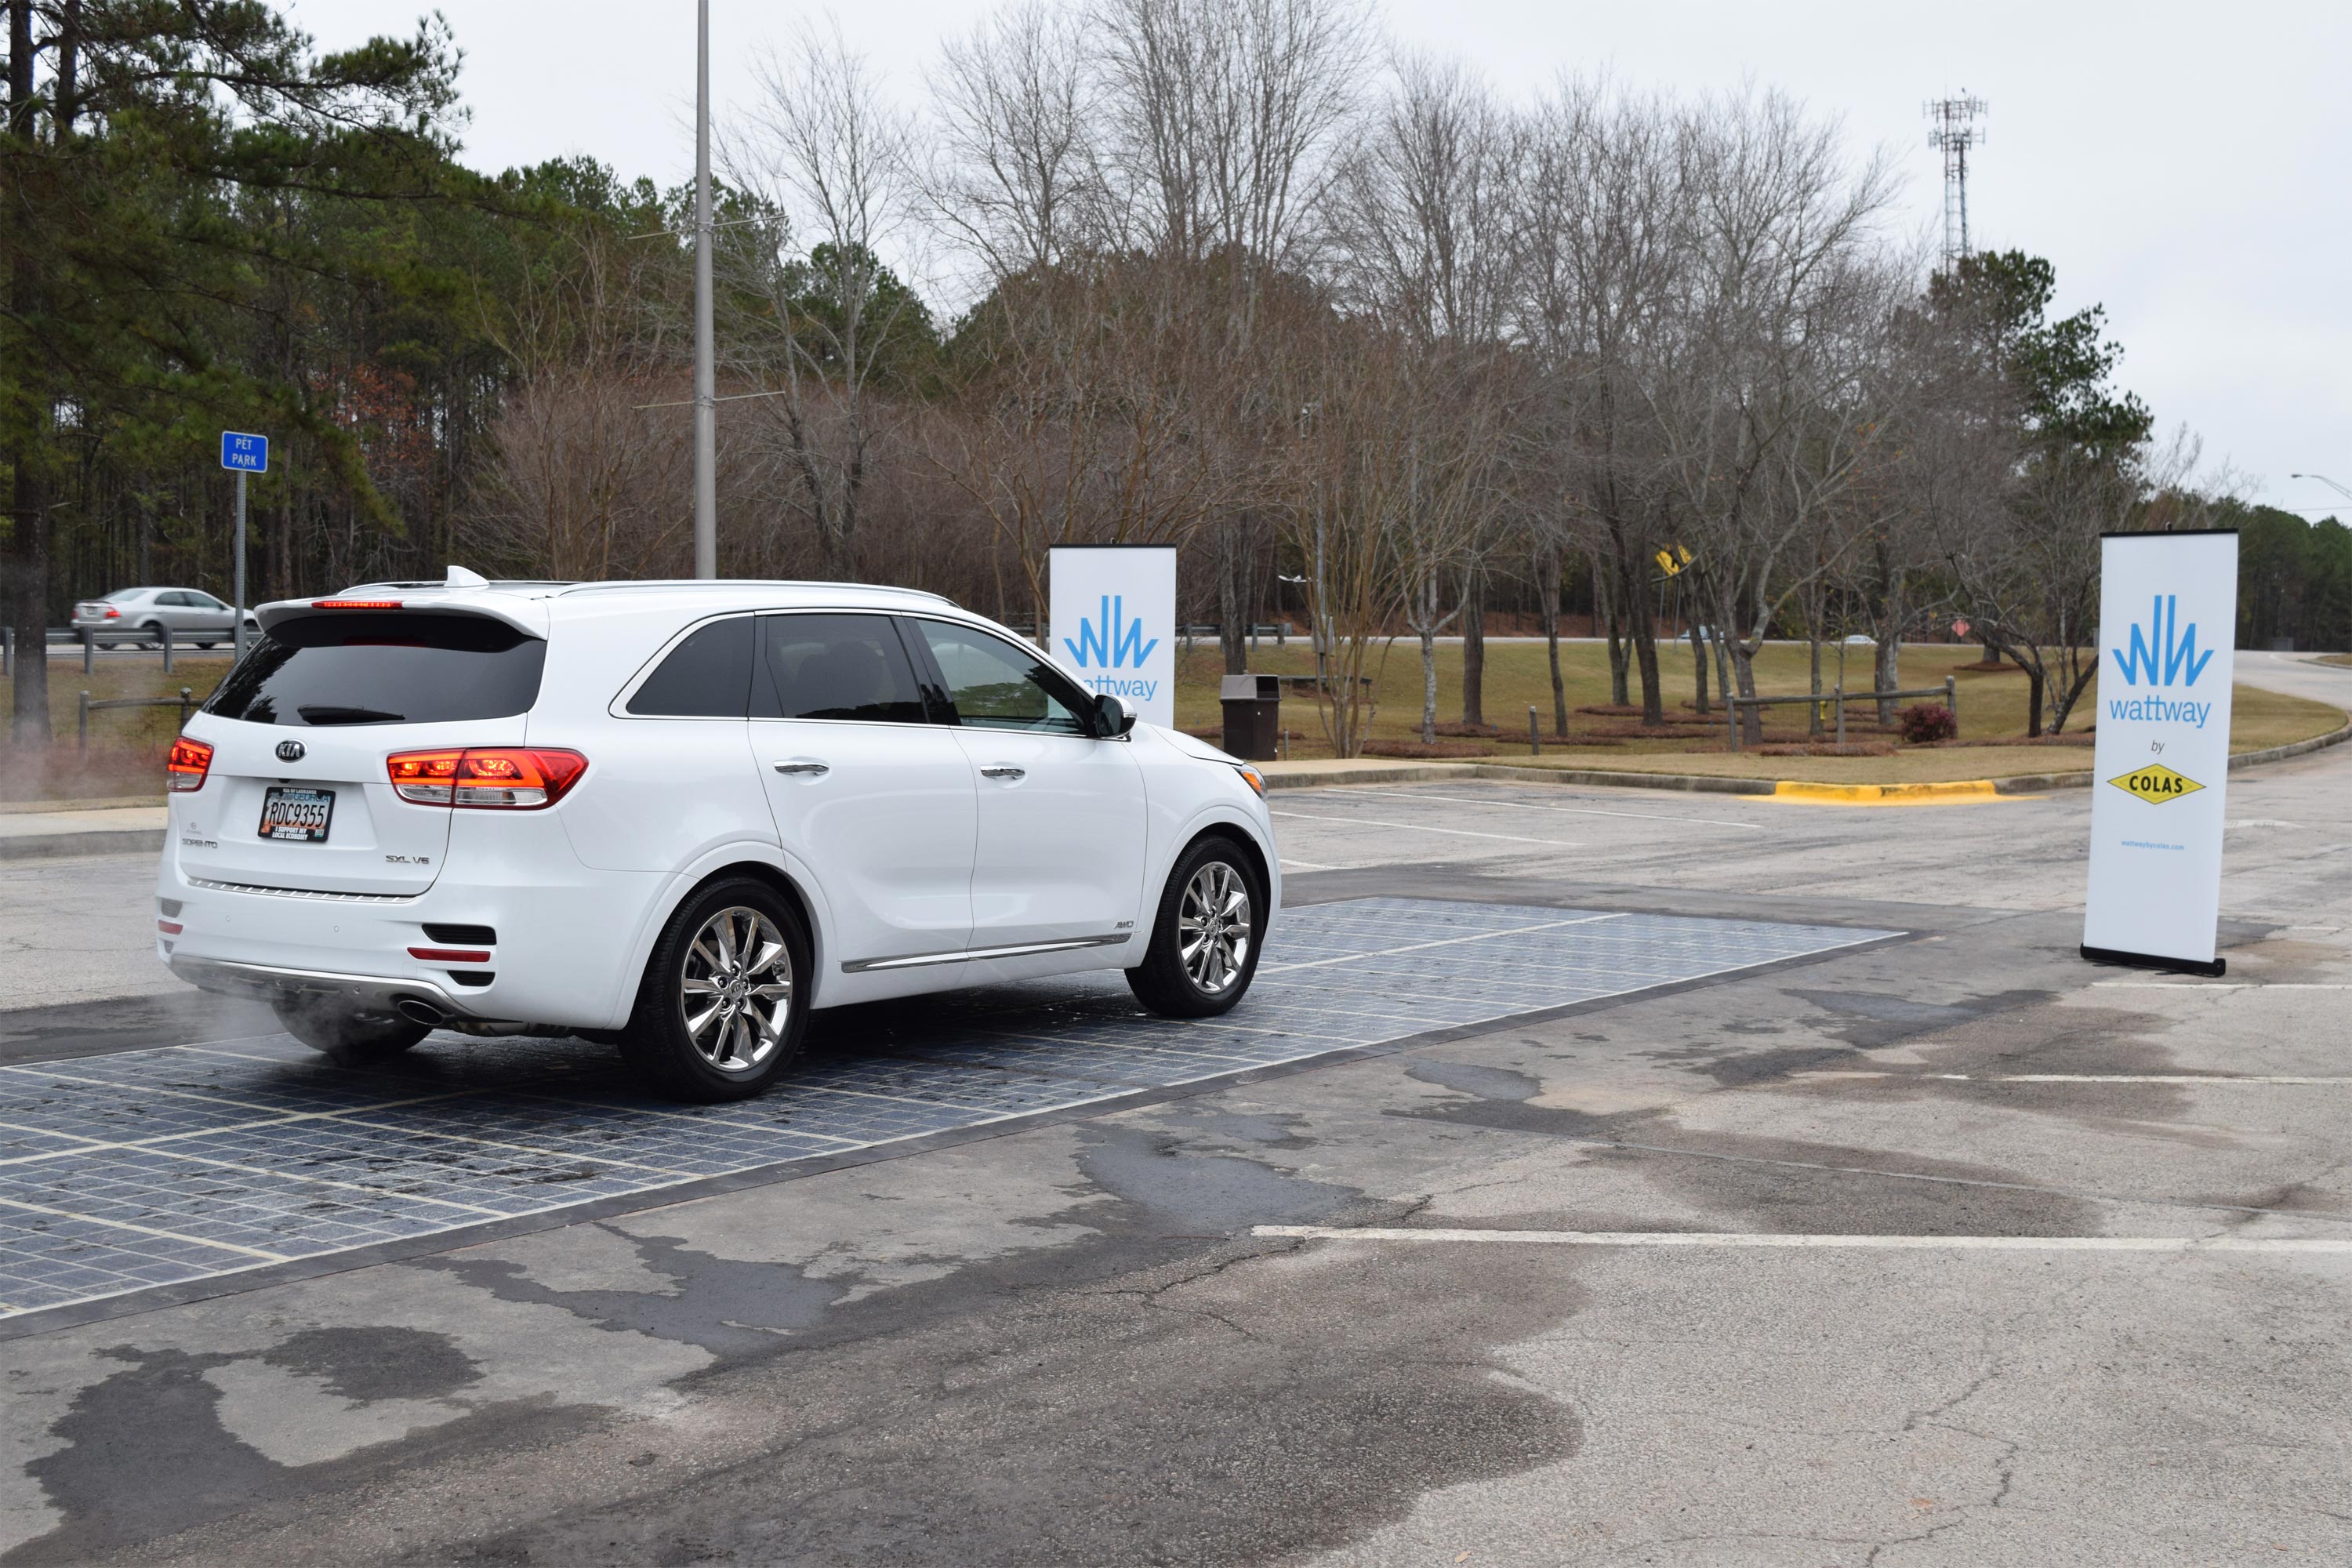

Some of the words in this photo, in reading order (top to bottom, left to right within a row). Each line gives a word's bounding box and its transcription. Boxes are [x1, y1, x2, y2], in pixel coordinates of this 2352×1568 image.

[236, 438, 252, 450] PET
[232, 453, 256, 466] PARK
[1083, 675, 1158, 702] ttway
[2110, 695, 2211, 728] wattway
[278, 743, 300, 757] KIA
[2151, 740, 2165, 755] by
[2129, 775, 2183, 793] COLAS
[269, 802, 325, 827] RDC9355
[1113, 920, 1134, 929] AWD
